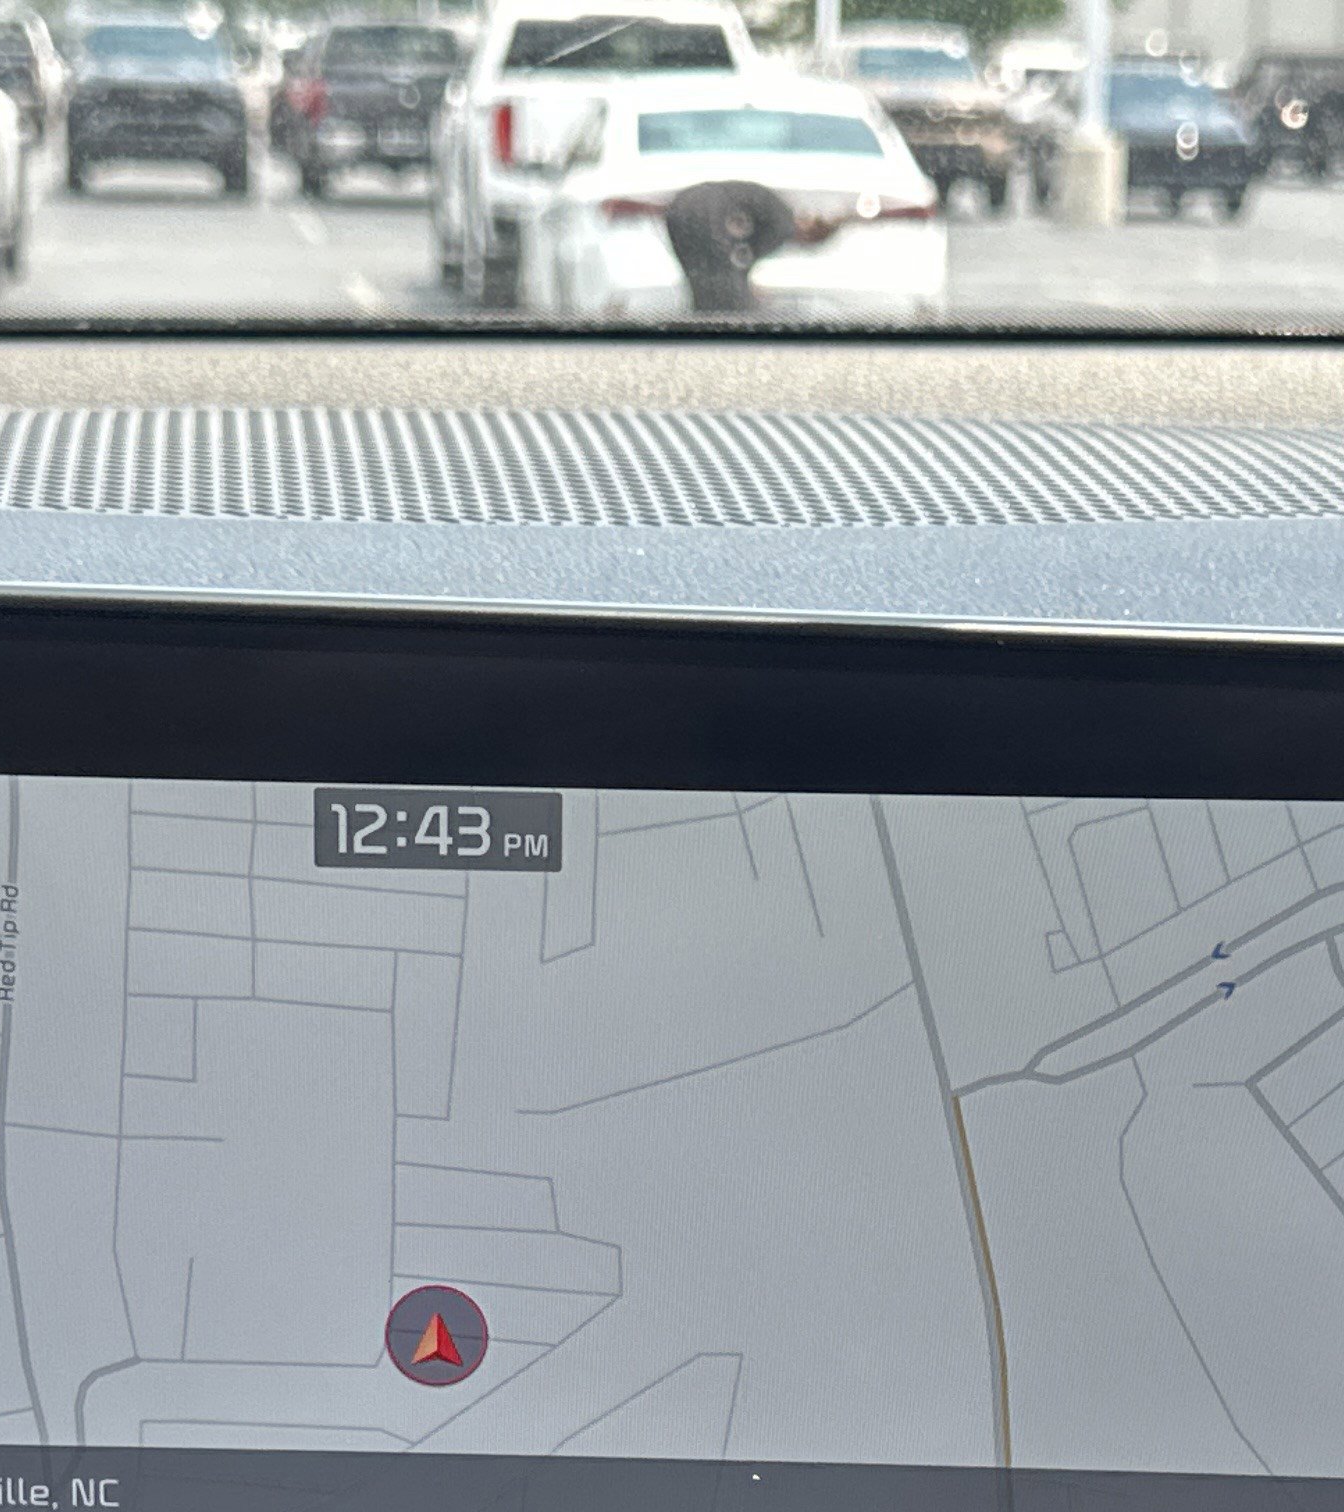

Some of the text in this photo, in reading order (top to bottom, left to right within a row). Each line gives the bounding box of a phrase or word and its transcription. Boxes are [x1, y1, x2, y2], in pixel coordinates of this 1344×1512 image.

[330, 803, 549, 858] 12:43 PM
[0, 884, 18, 914] Rd
[0, 918, 18, 951] Tip
[72, 1480, 120, 1507] NC
